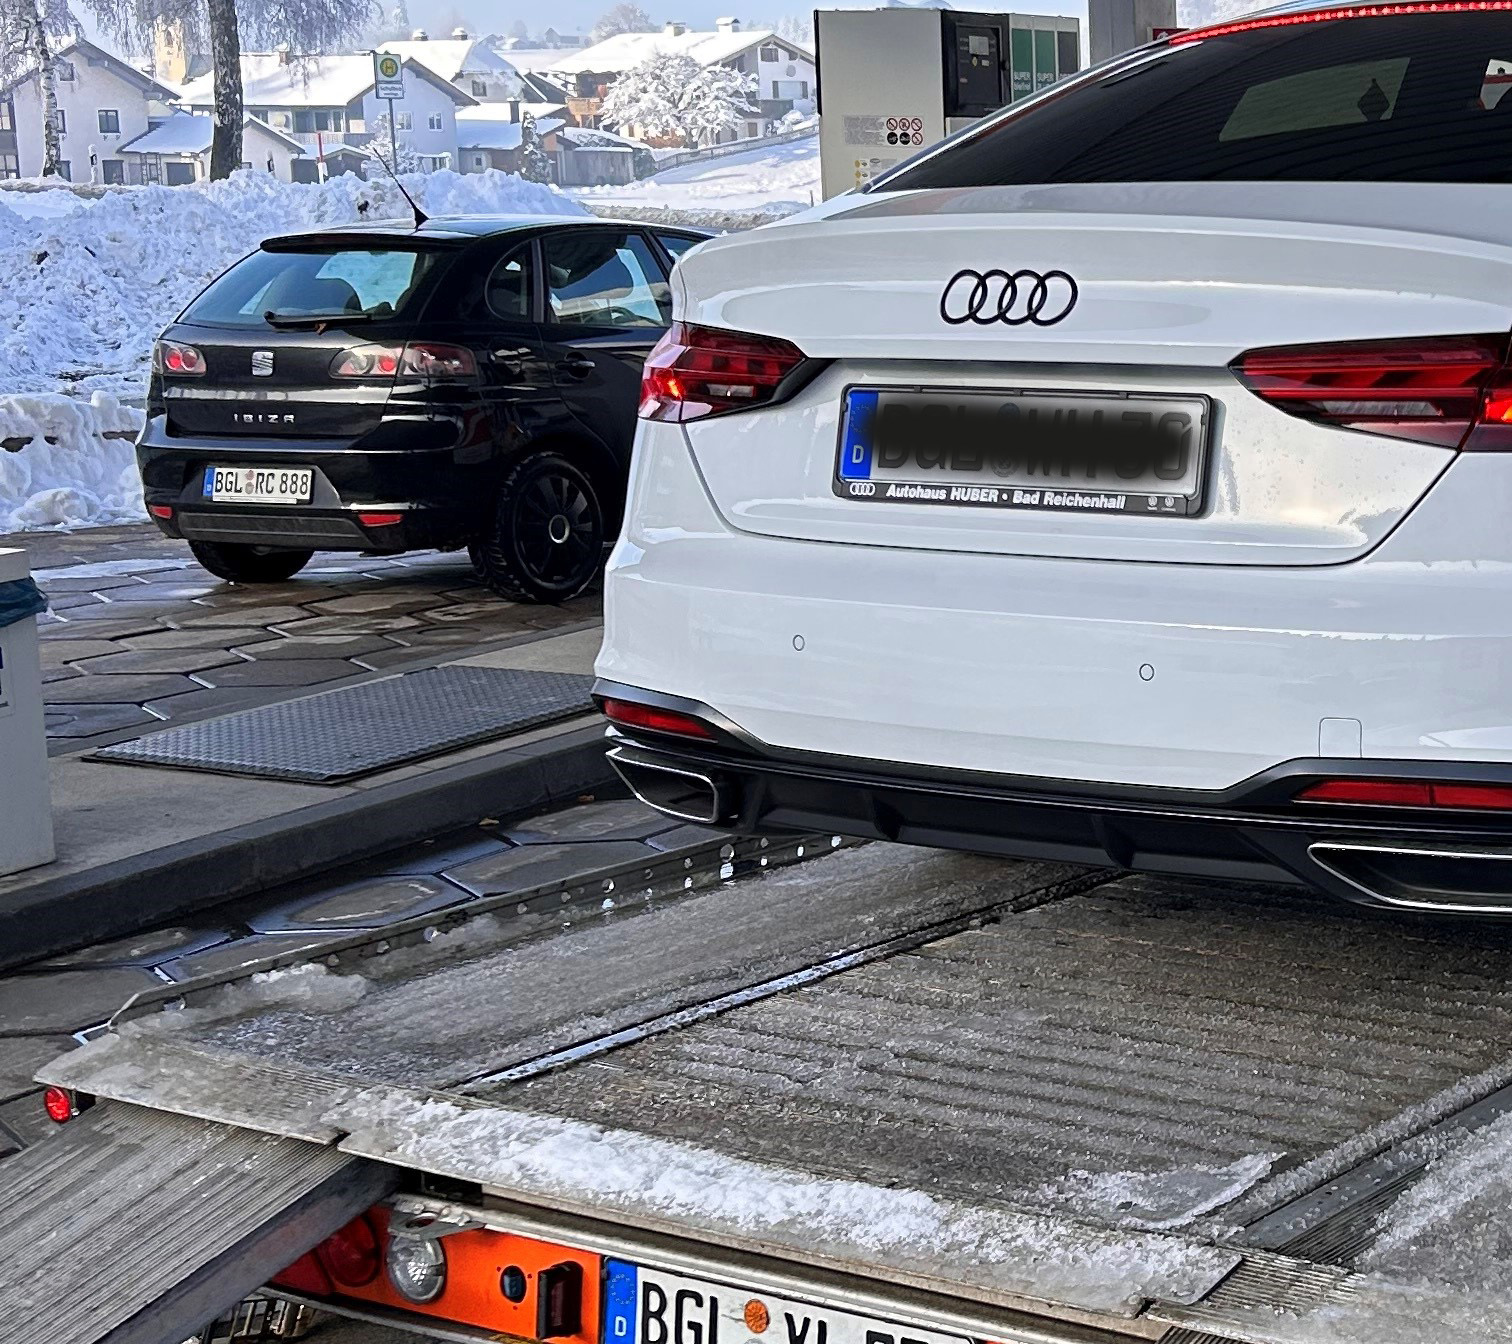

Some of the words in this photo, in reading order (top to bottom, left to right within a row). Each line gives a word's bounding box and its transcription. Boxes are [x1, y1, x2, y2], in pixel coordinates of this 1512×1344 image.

[233, 413, 295, 424] IBIZA
[852, 444, 864, 464] D
[214, 471, 243, 494] BGL
[254, 472, 276, 495] RC
[279, 472, 309, 496] 888
[886, 483, 947, 501] Autohaus
[950, 487, 999, 503] HUBER
[1012, 490, 1039, 506] Bad
[1046, 492, 1126, 509] Reichenhall
[614, 1315, 627, 1337] D
